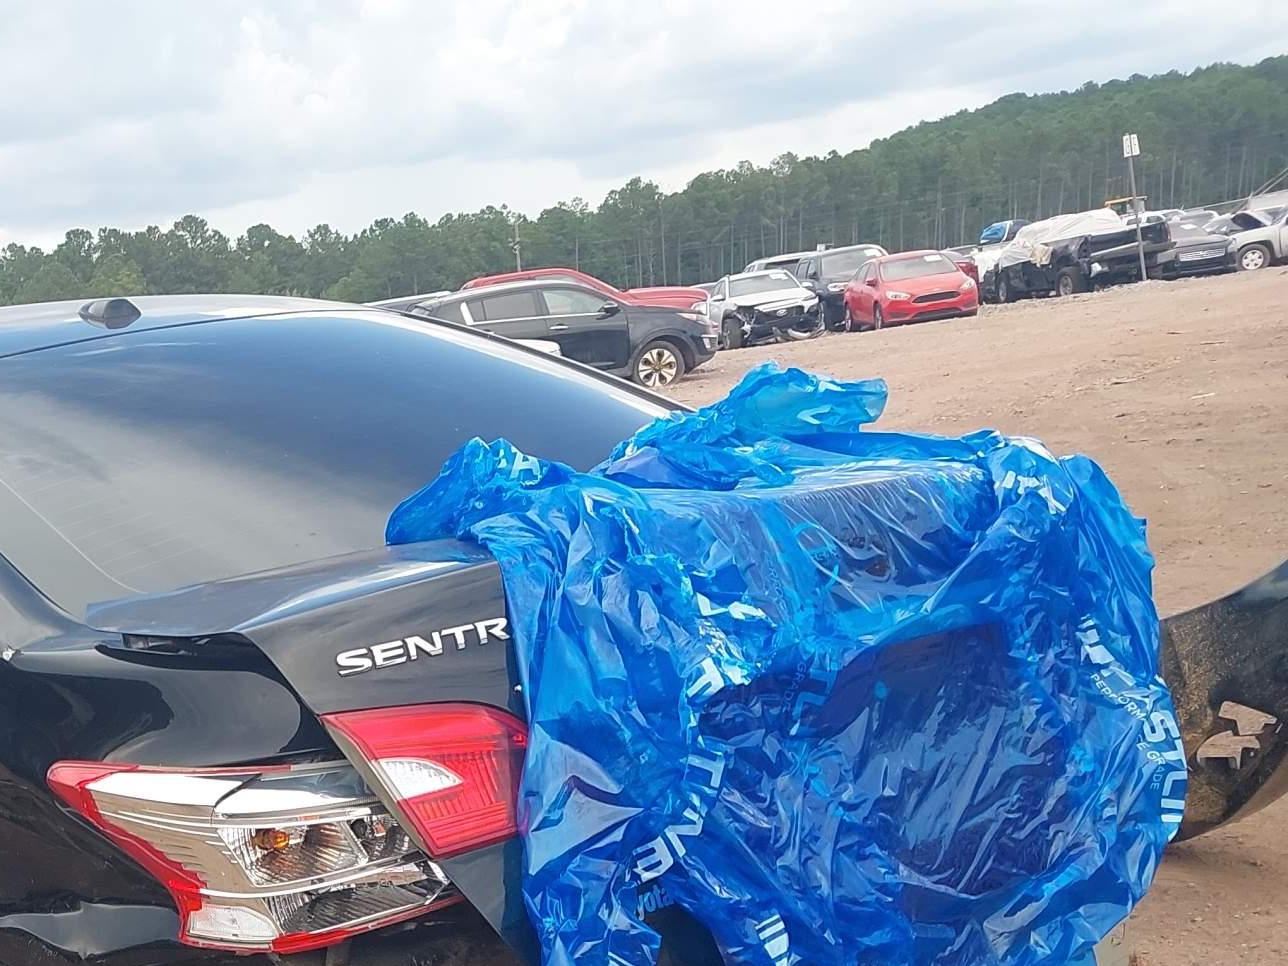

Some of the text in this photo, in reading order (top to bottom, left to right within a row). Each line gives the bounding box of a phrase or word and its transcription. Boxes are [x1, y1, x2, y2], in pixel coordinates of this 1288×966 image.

[336, 617, 510, 677] SENTR
[1146, 750, 1167, 791] GRADE
[636, 884, 674, 921] yota
